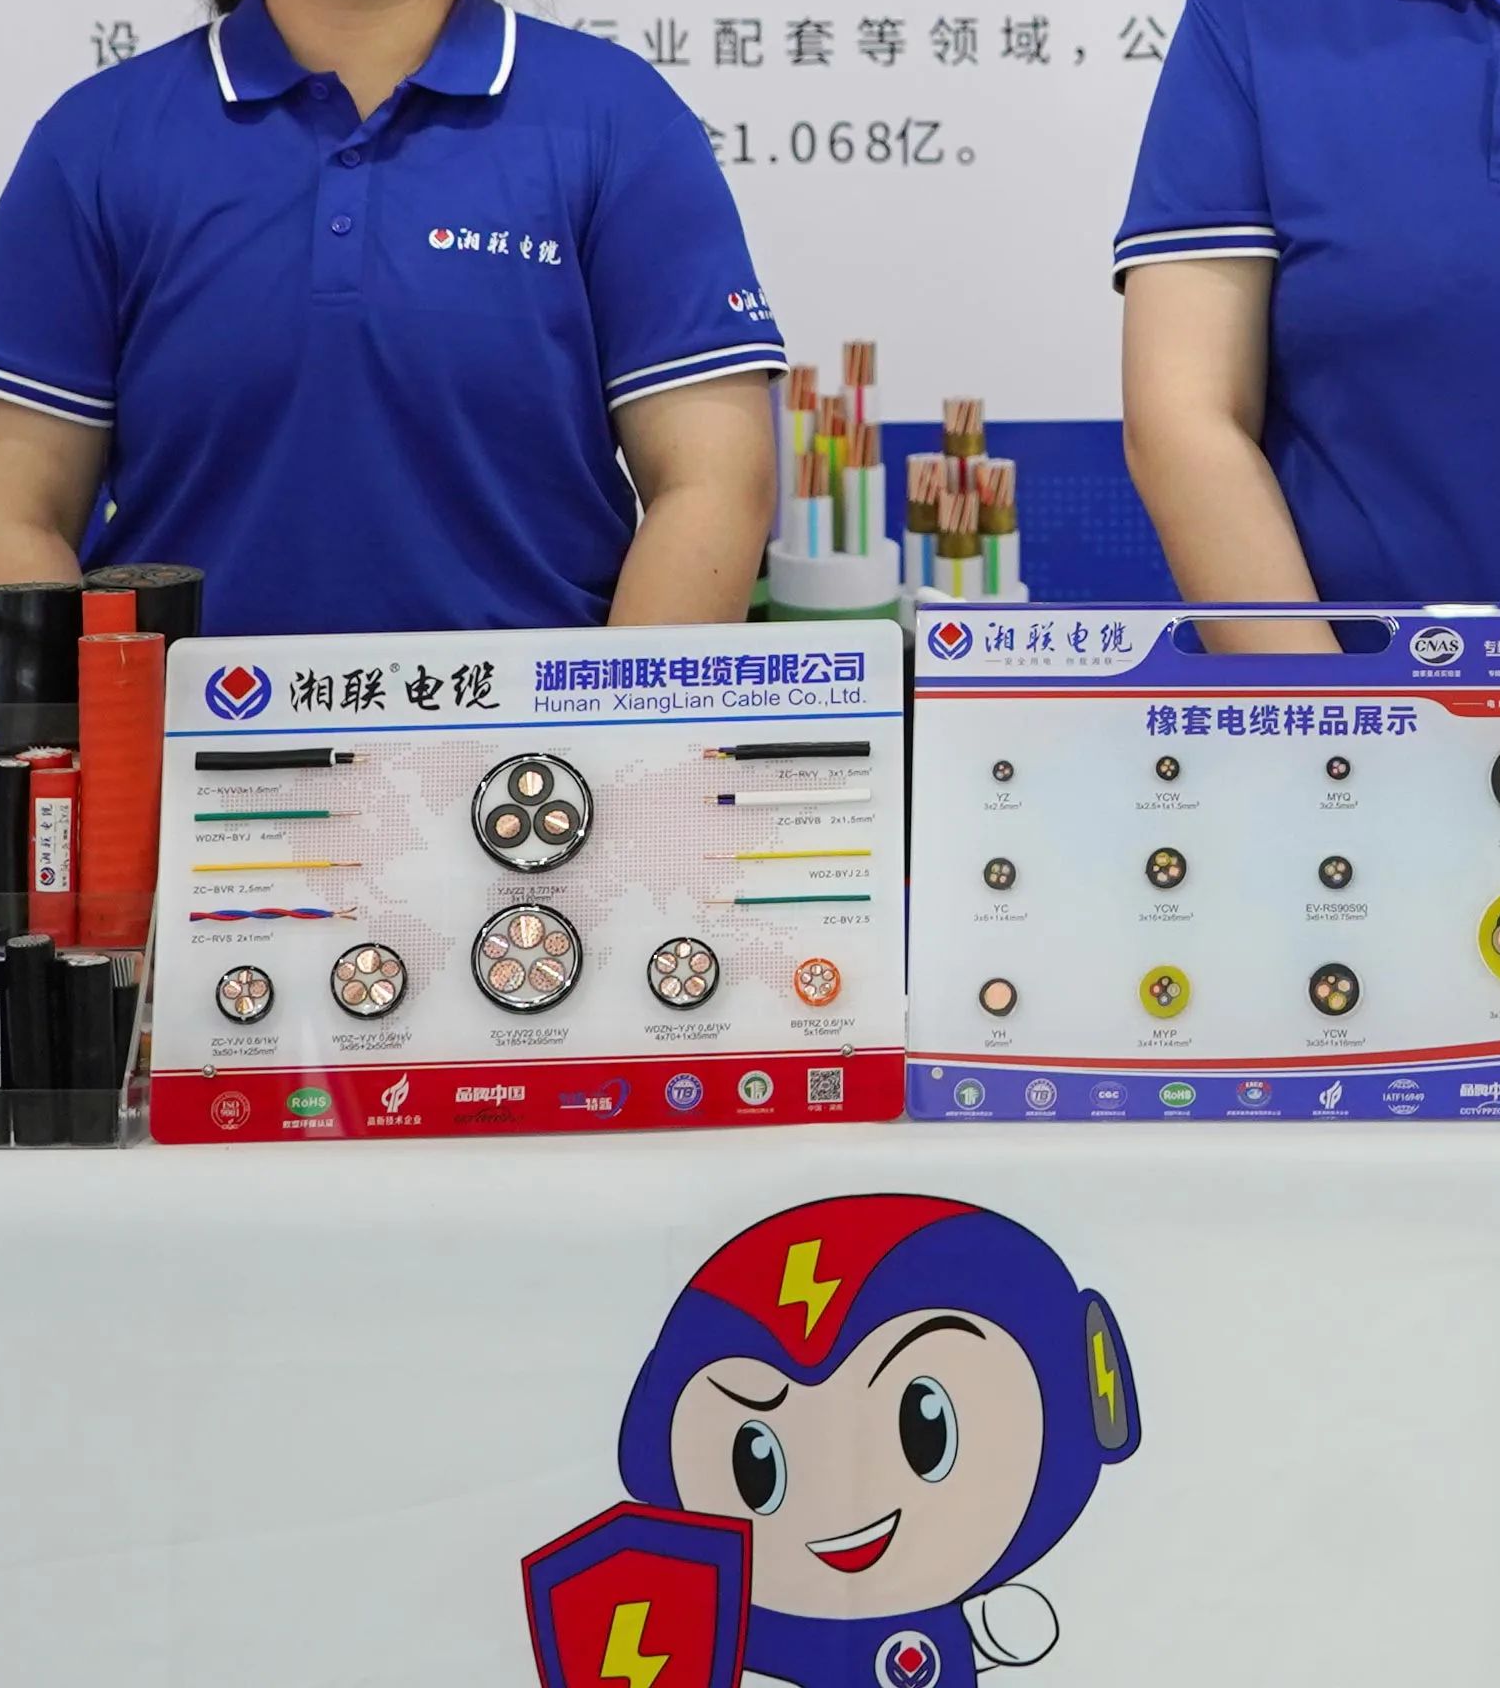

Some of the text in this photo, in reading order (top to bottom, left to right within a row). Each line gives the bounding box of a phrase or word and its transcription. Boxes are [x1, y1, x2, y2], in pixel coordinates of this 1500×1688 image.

[456, 228, 561, 265] 湘联电缆
[984, 620, 1133, 654] 湘联电缆
[1414, 640, 1460, 652] CNAS
[535, 652, 865, 691] 湖南湘联电缆有限公司
[535, 686, 867, 714] Hunan XiangLian Cable Co.,Ltd.
[1146, 704, 1418, 736] 橡套电缆样品展示
[997, 793, 1010, 801] YZ
[1156, 793, 1180, 801] YCW
[1327, 792, 1350, 802] MYQ
[856, 870, 869, 878] 2.5
[994, 904, 1008, 913] YC
[1154, 904, 1179, 913] YCW
[823, 915, 870, 924] ZC-BV 2.5
[992, 1030, 1006, 1039] YH
[1153, 1030, 1177, 1039] MYP
[1323, 1030, 1347, 1038] YCW
[1163, 1090, 1191, 1100] RoHS
[1382, 1092, 1425, 1102] IATF16949
[292, 1096, 326, 1108] RoHS
